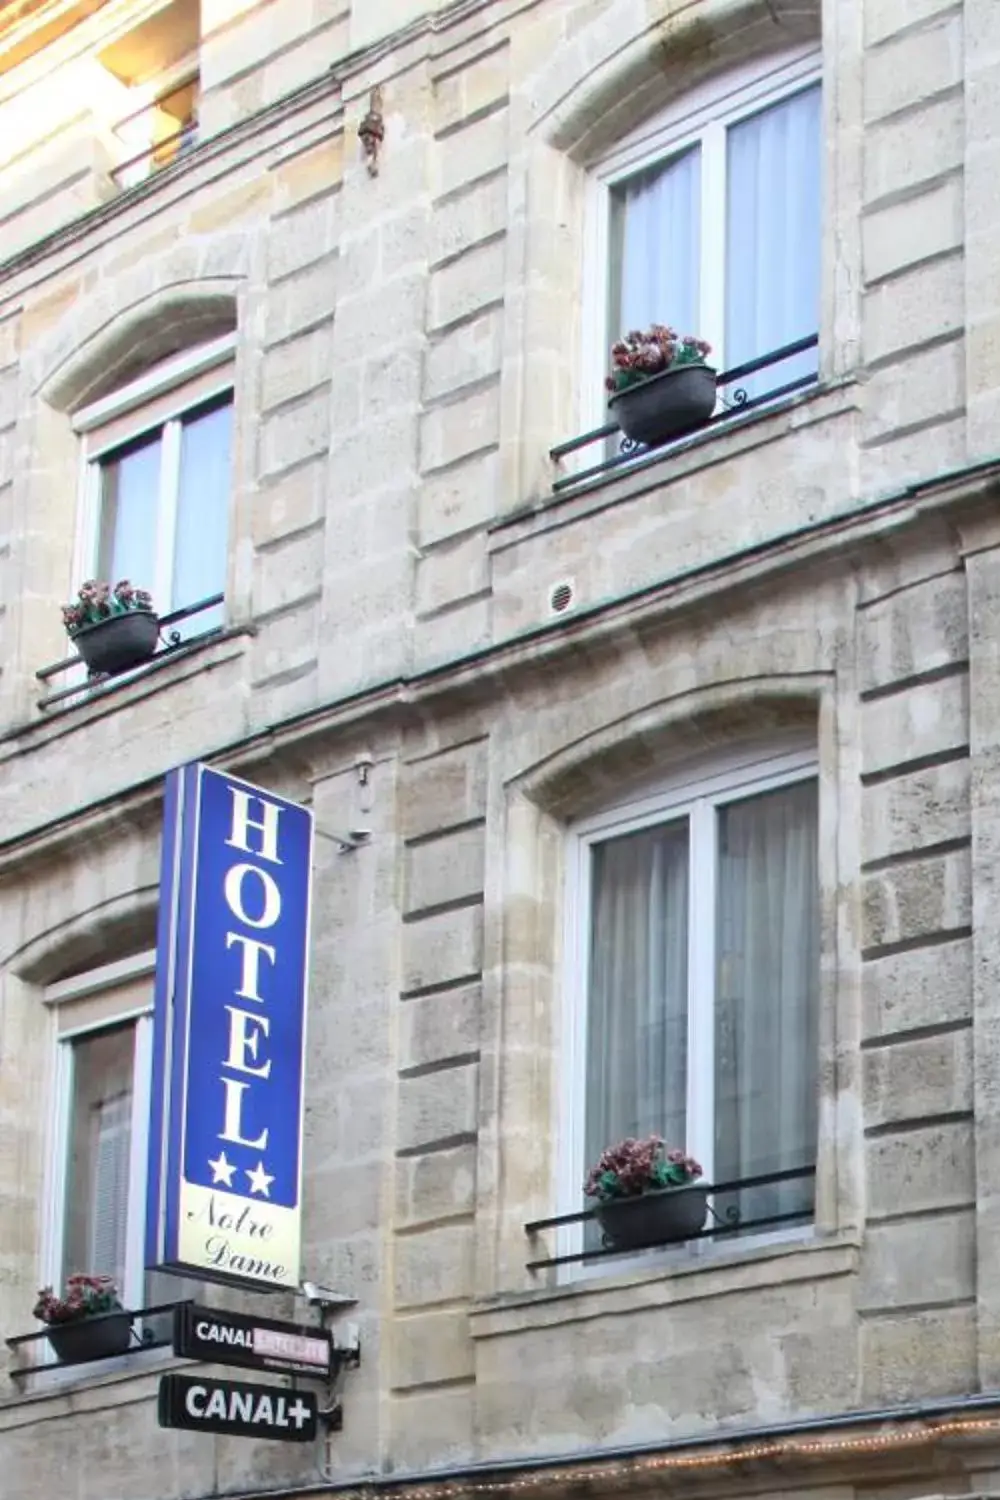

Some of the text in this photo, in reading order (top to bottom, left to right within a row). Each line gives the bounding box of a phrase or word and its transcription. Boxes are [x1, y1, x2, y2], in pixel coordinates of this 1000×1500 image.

[217, 785, 284, 1150] HOTEL
[187, 1194, 274, 1239] Notre
[205, 1234, 288, 1279] Dame
[196, 1321, 253, 1348] CANAL
[185, 1385, 311, 1429] CANAL+
